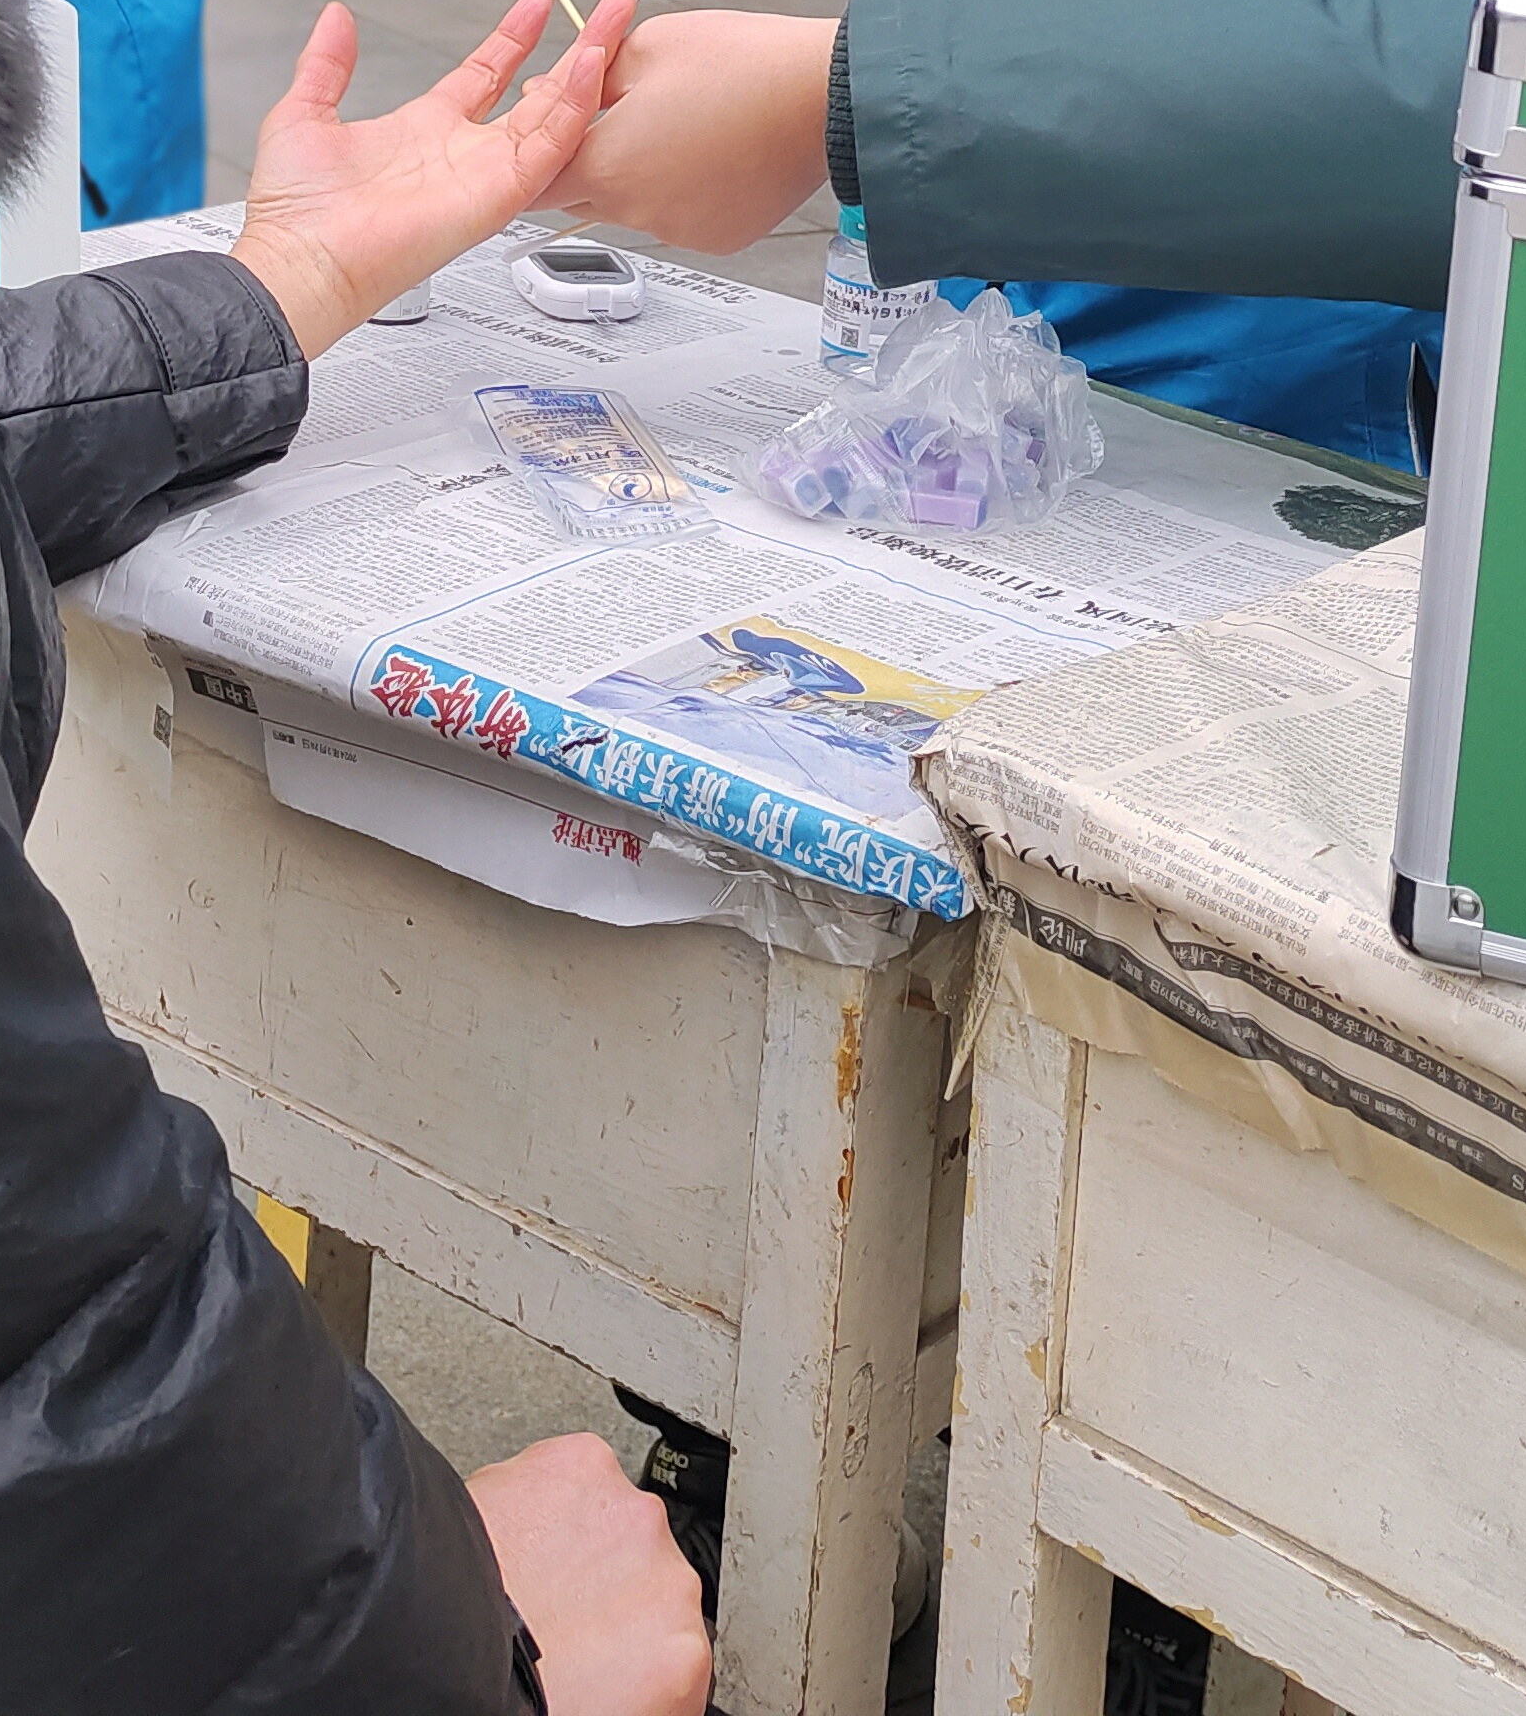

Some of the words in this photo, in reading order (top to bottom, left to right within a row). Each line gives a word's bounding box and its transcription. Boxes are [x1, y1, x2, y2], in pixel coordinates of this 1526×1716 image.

[370, 660, 967, 920] 来医院”的“游乐就医”新体验
[552, 812, 646, 864] 视点评论
[1033, 912, 1089, 961] 理论
[1147, 977, 1220, 1031] 2024年3月19日
